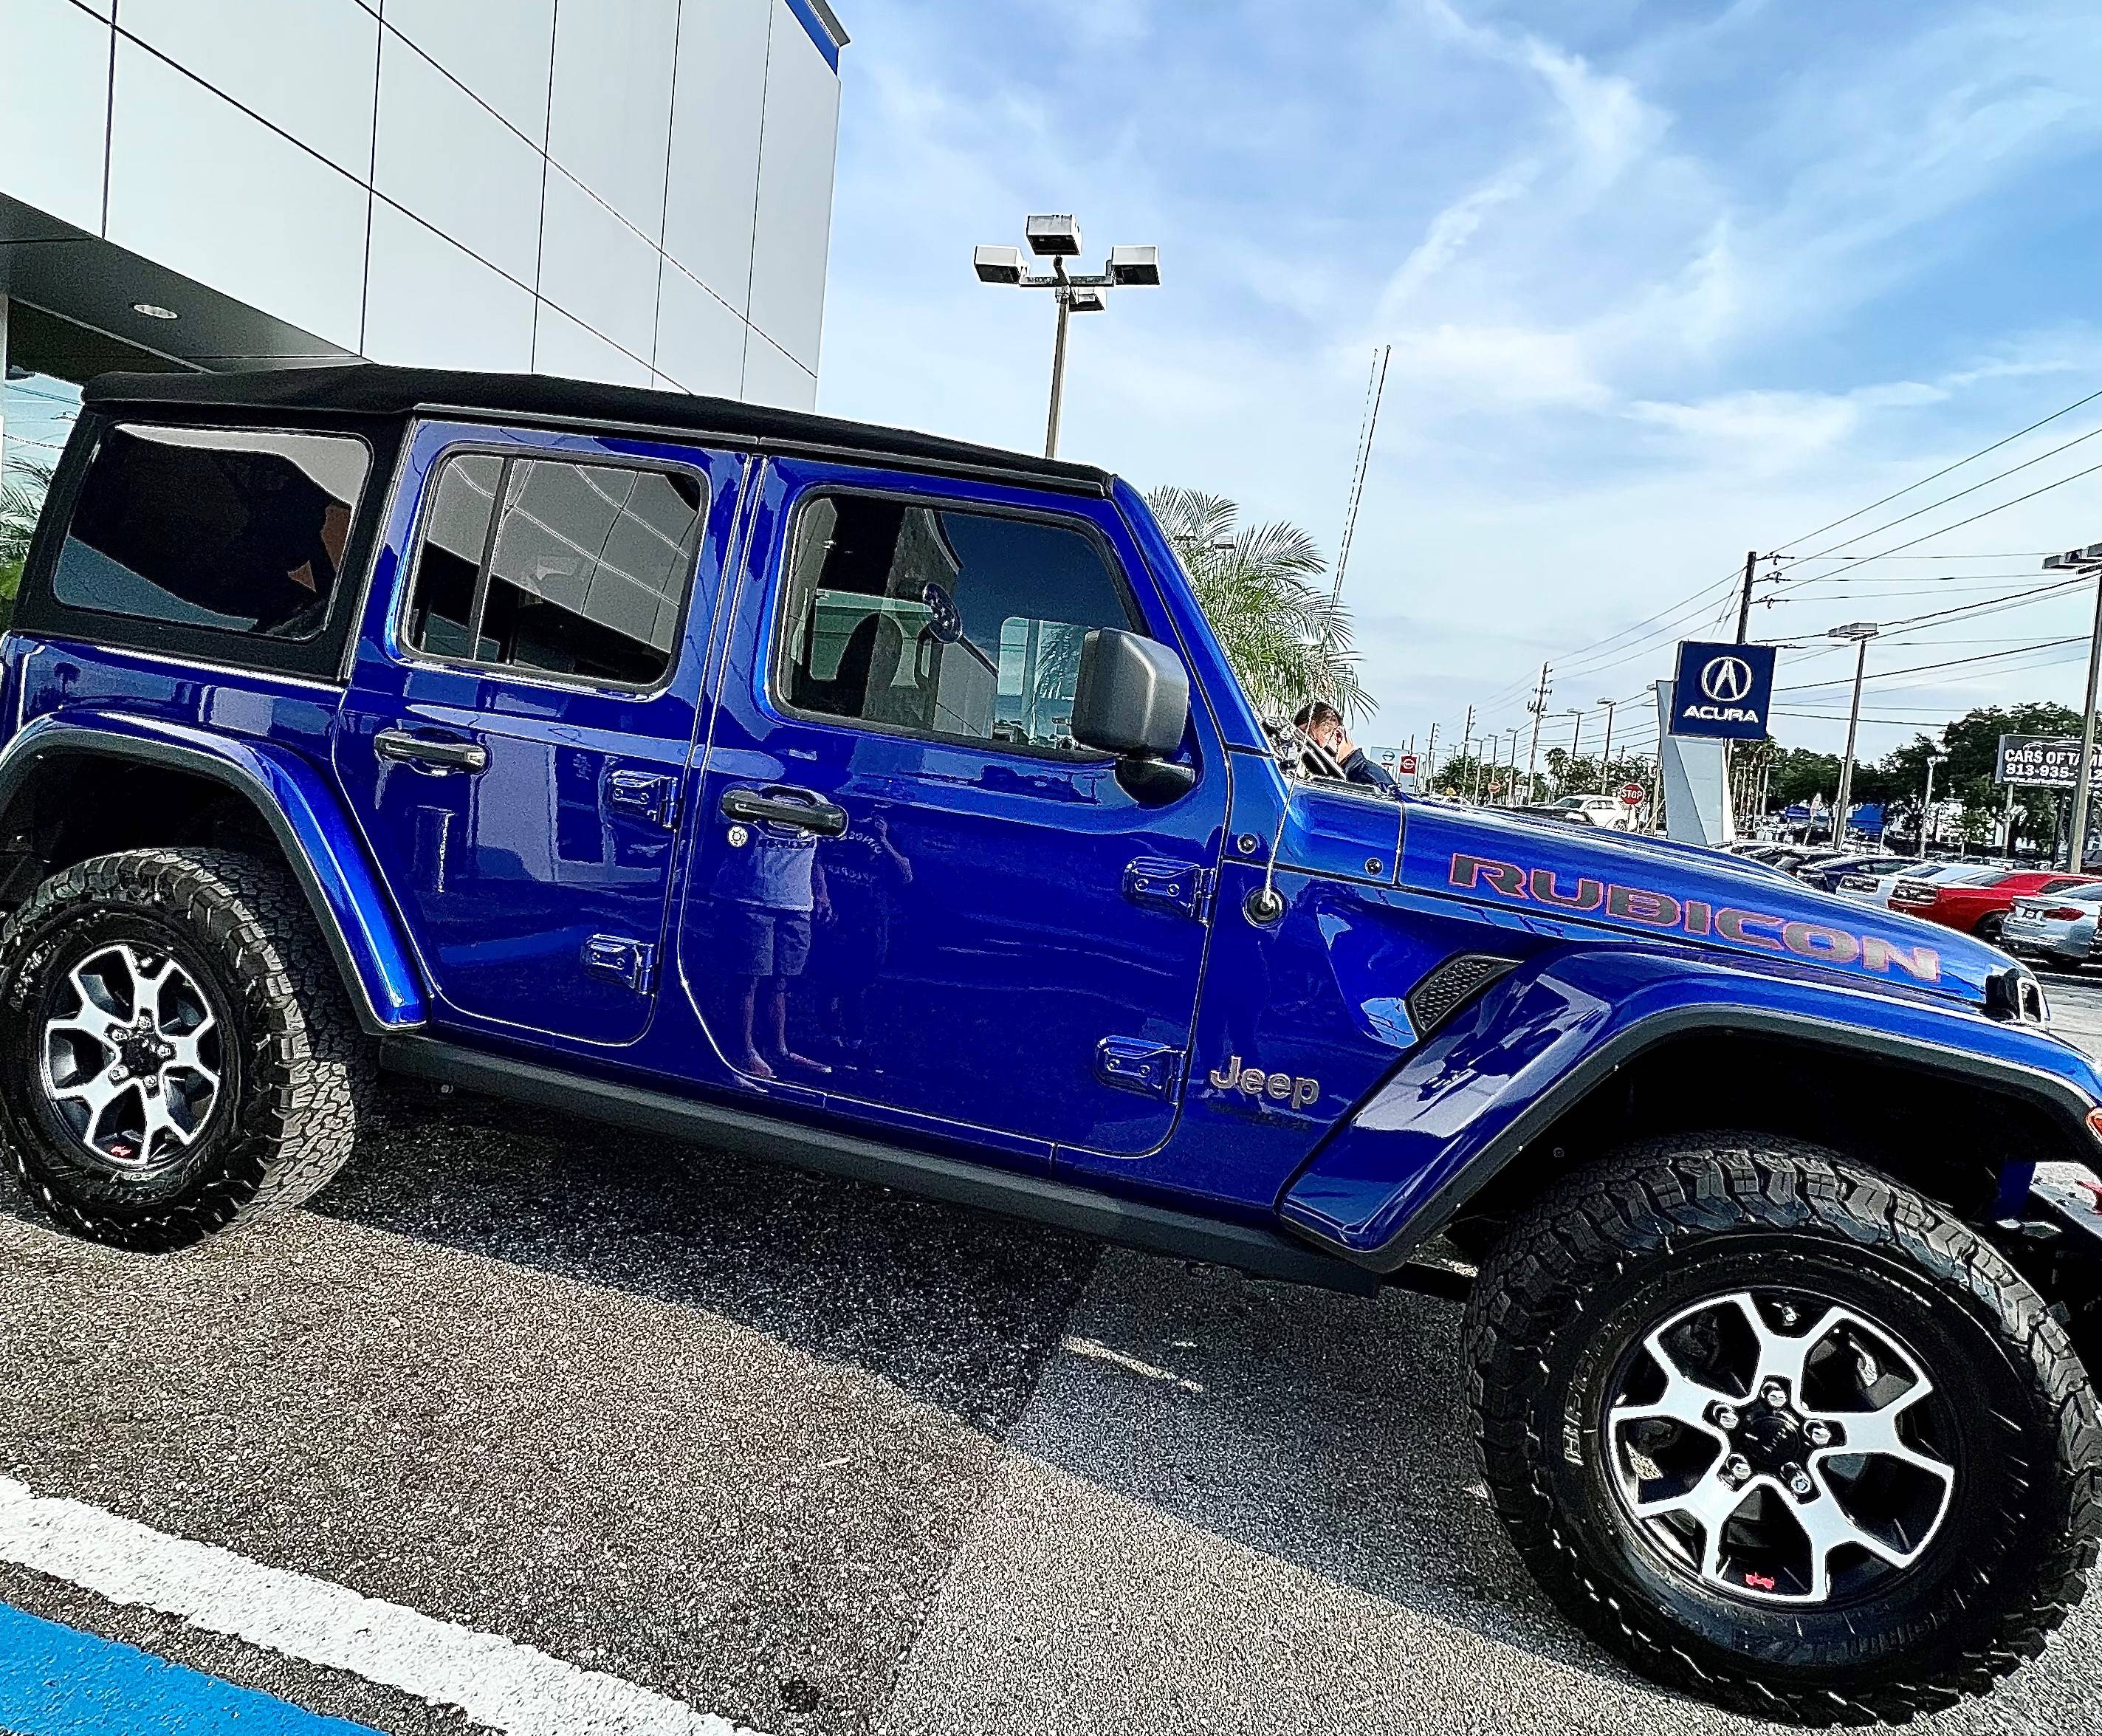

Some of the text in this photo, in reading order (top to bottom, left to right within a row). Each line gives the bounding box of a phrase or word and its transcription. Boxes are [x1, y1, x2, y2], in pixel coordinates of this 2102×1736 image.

[1683, 705, 1759, 723] ACURA
[2005, 749, 2043, 764] CARS
[2046, 751, 2067, 765] OF
[1621, 789, 1642, 799] STOP
[1448, 852, 1940, 983] RUBICON
[1210, 1055, 1320, 1109] Jeep
